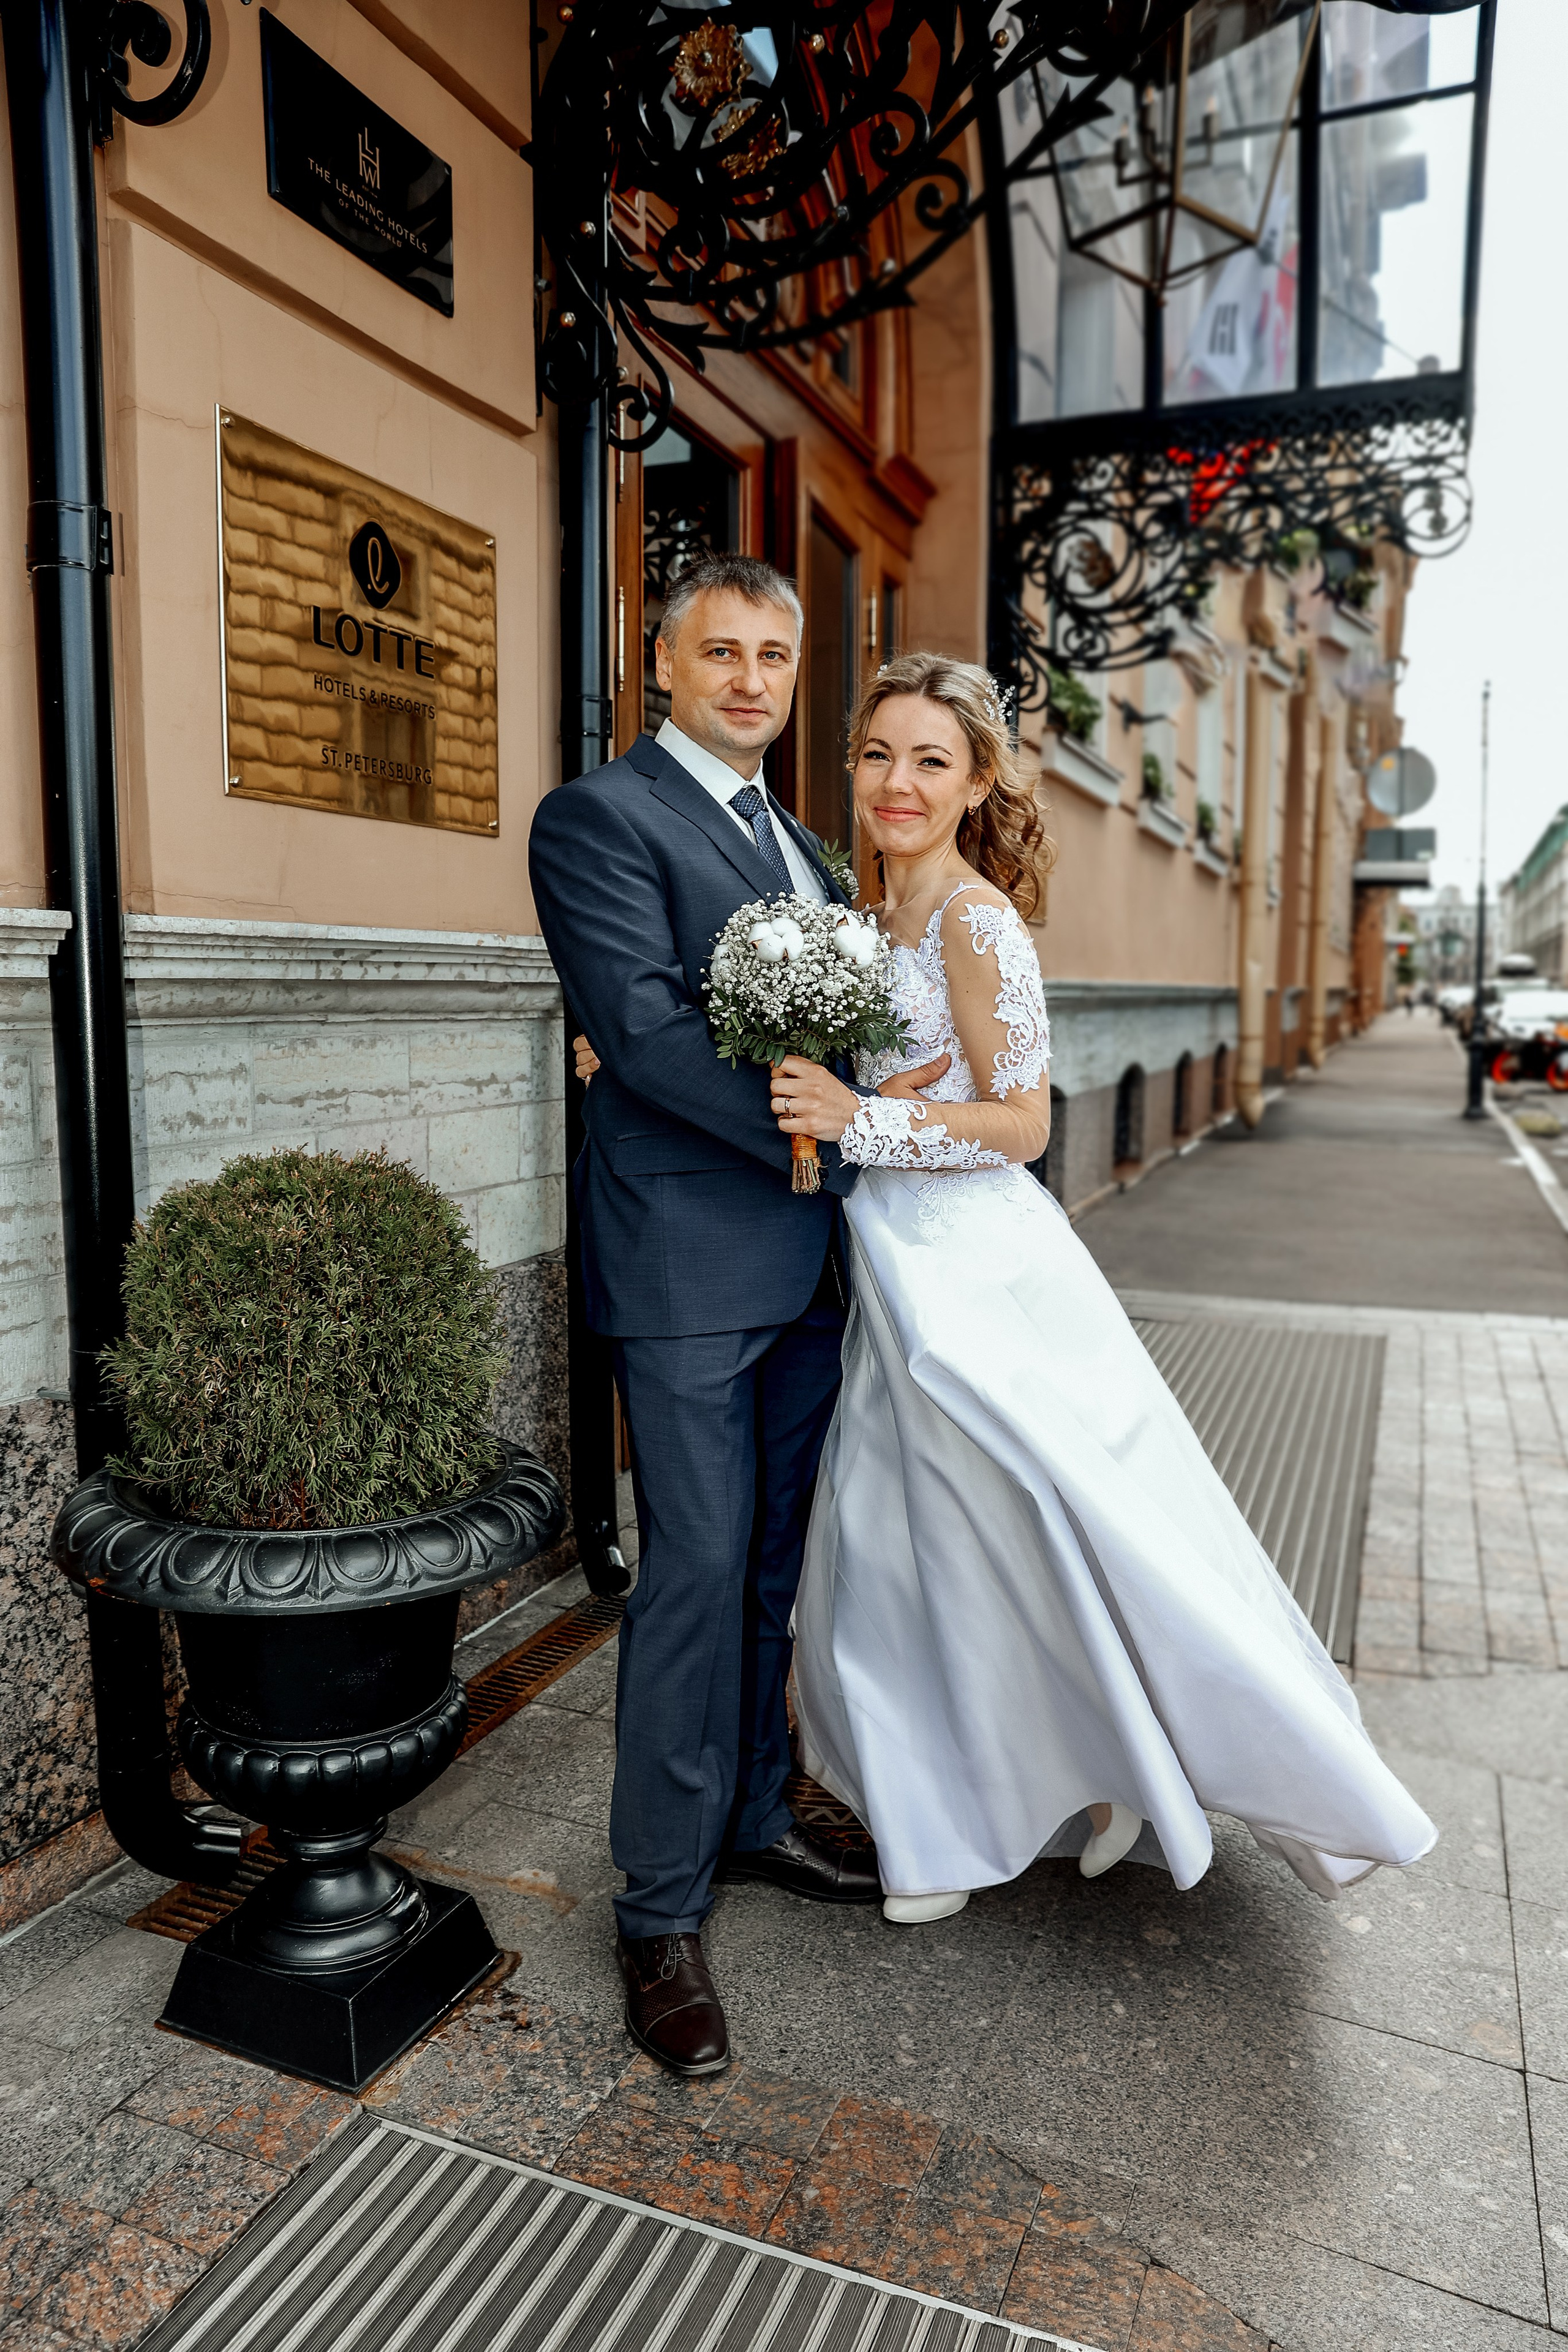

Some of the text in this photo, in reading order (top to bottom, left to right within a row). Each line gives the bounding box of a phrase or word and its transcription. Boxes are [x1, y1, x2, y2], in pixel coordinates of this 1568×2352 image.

[307, 157, 428, 254] THE LEADING HOTELS
[338, 198, 402, 247] OF THE WORLD
[312, 605, 435, 679] LOTTE
[314, 674, 435, 720] HOTELS & RESORTS
